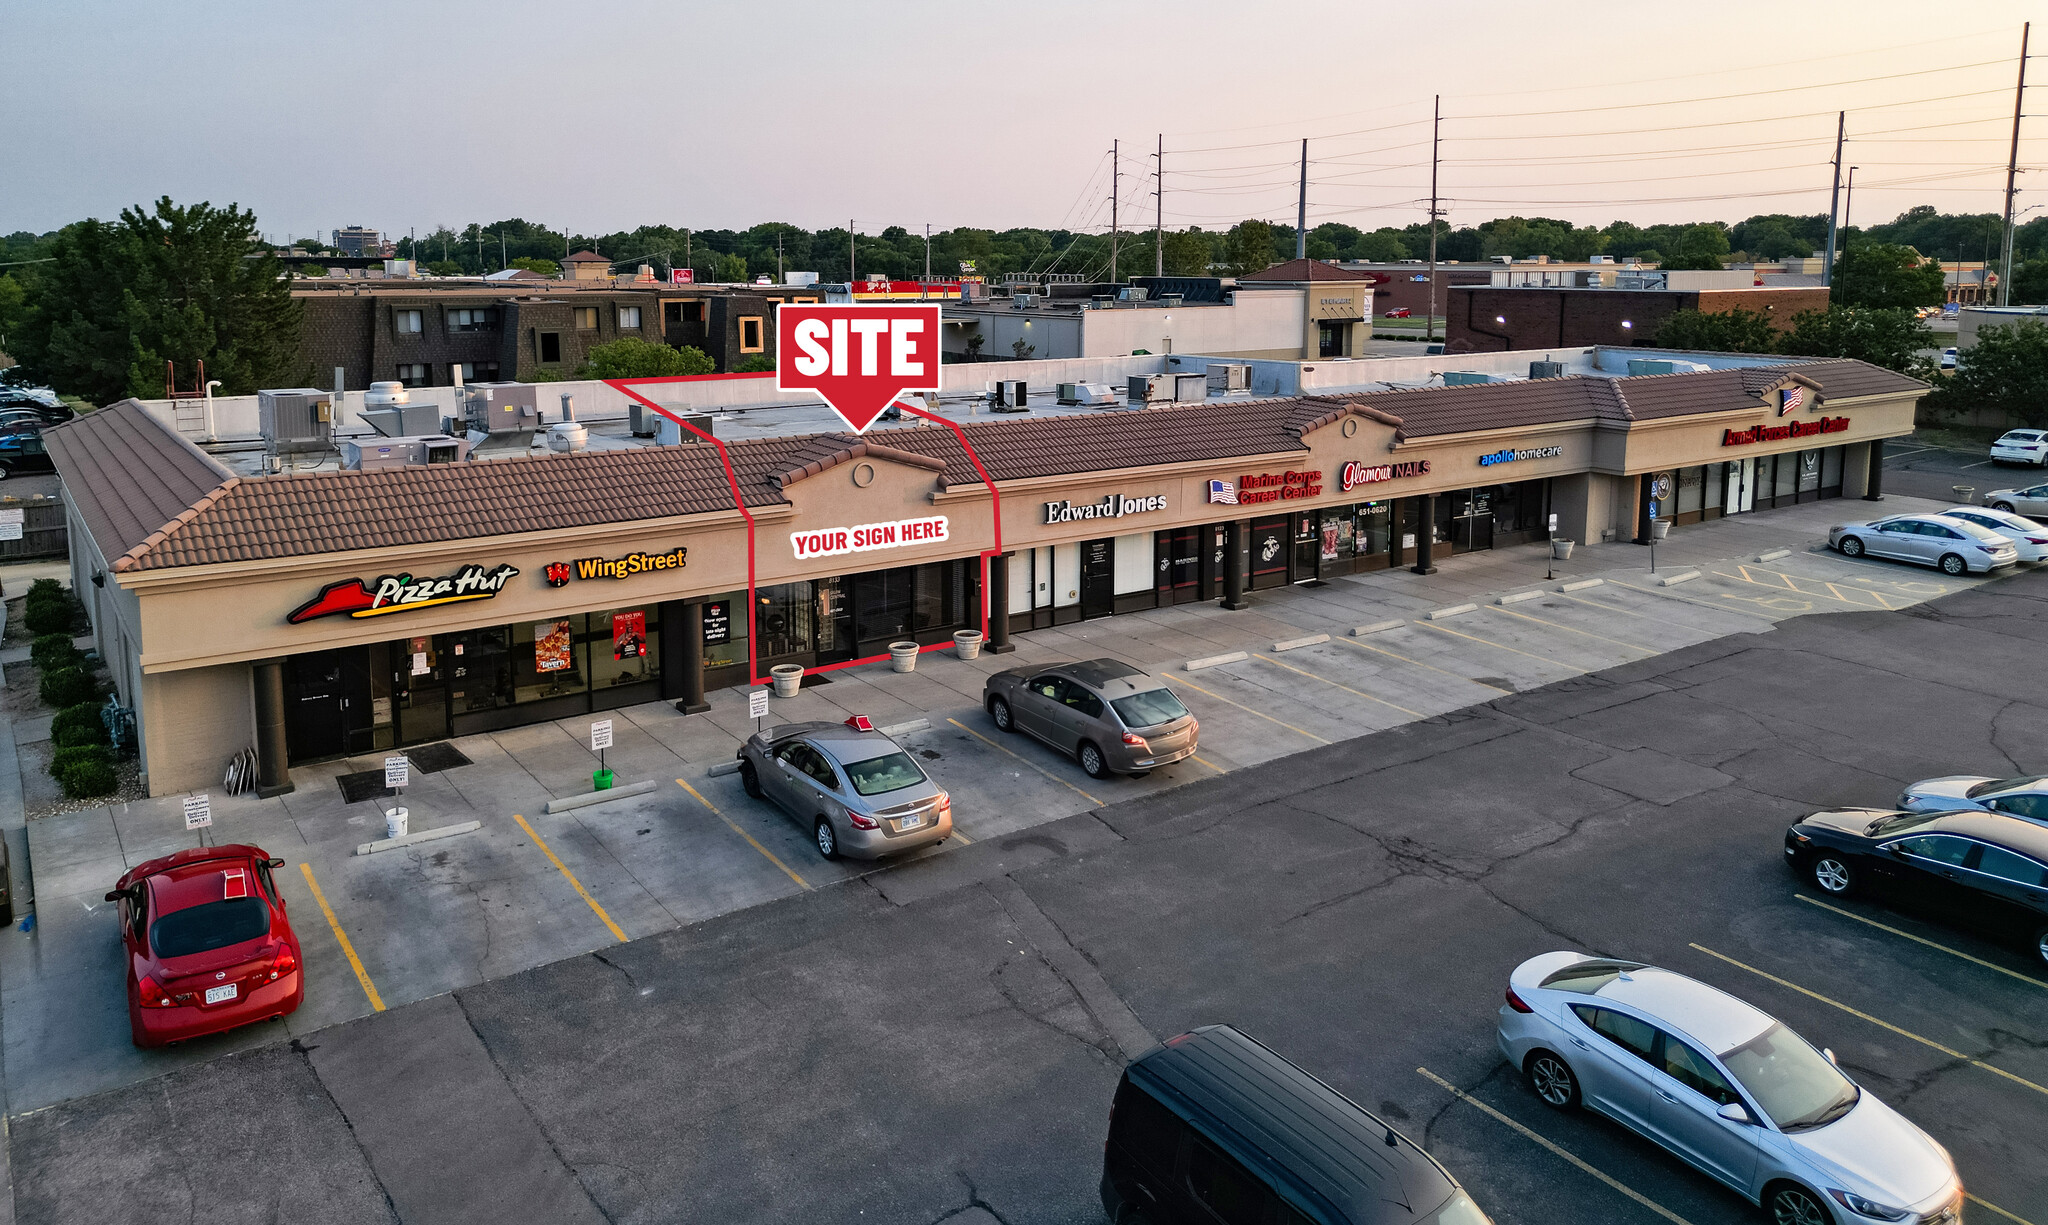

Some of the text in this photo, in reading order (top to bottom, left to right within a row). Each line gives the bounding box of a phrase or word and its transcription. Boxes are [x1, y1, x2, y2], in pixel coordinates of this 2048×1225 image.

[1724, 416, 1850, 446] Armed Forces Career Center
[1481, 445, 1563, 467] apollohomecare
[1242, 469, 1322, 490] Marine Corps
[1343, 460, 1431, 492] Glamour NAILS
[1239, 484, 1323, 505] Career Center
[1046, 494, 1168, 525] Edward Jones
[1358, 505, 1387, 516] 651-0620
[578, 549, 685, 579] WingStreet
[372, 567, 519, 609] Pizza Hut
[540, 659, 565, 669] Tavern
[185, 800, 209, 808] PARKING
